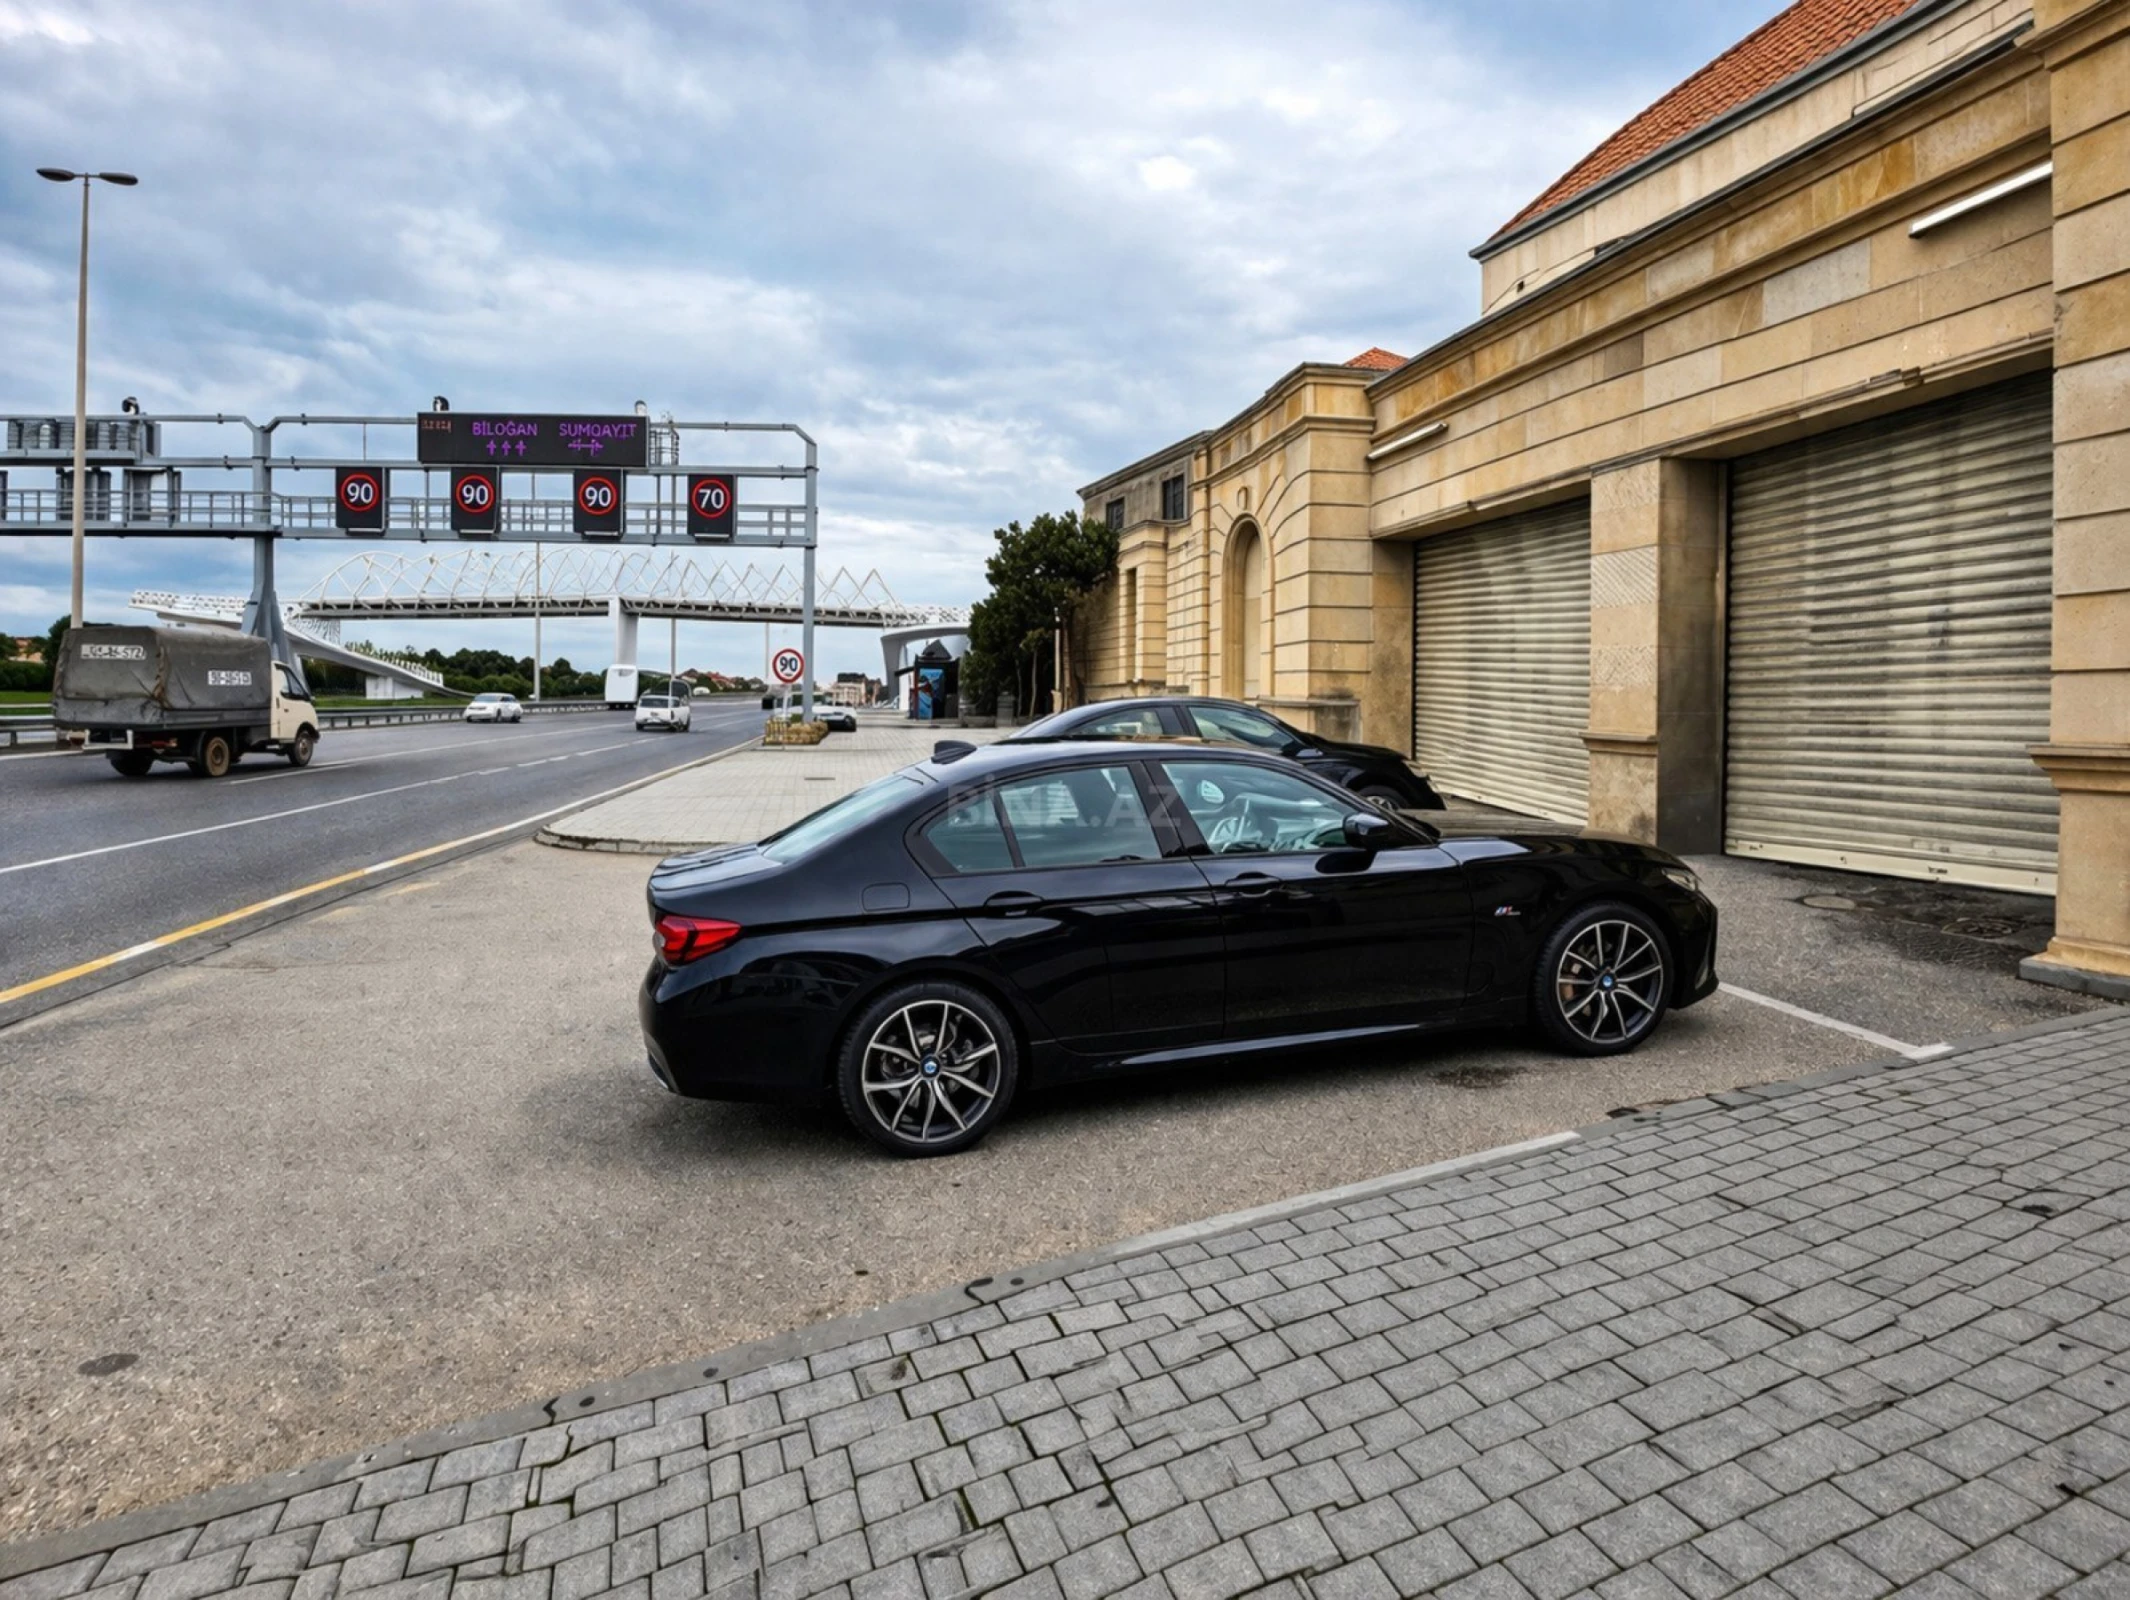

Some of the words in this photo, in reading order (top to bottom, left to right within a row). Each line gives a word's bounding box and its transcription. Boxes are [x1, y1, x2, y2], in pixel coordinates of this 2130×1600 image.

[347, 482, 373, 503] 90
[462, 484, 489, 505] 90
[585, 487, 611, 507] 90
[699, 488, 724, 509] 70
[780, 656, 798, 672] 90
